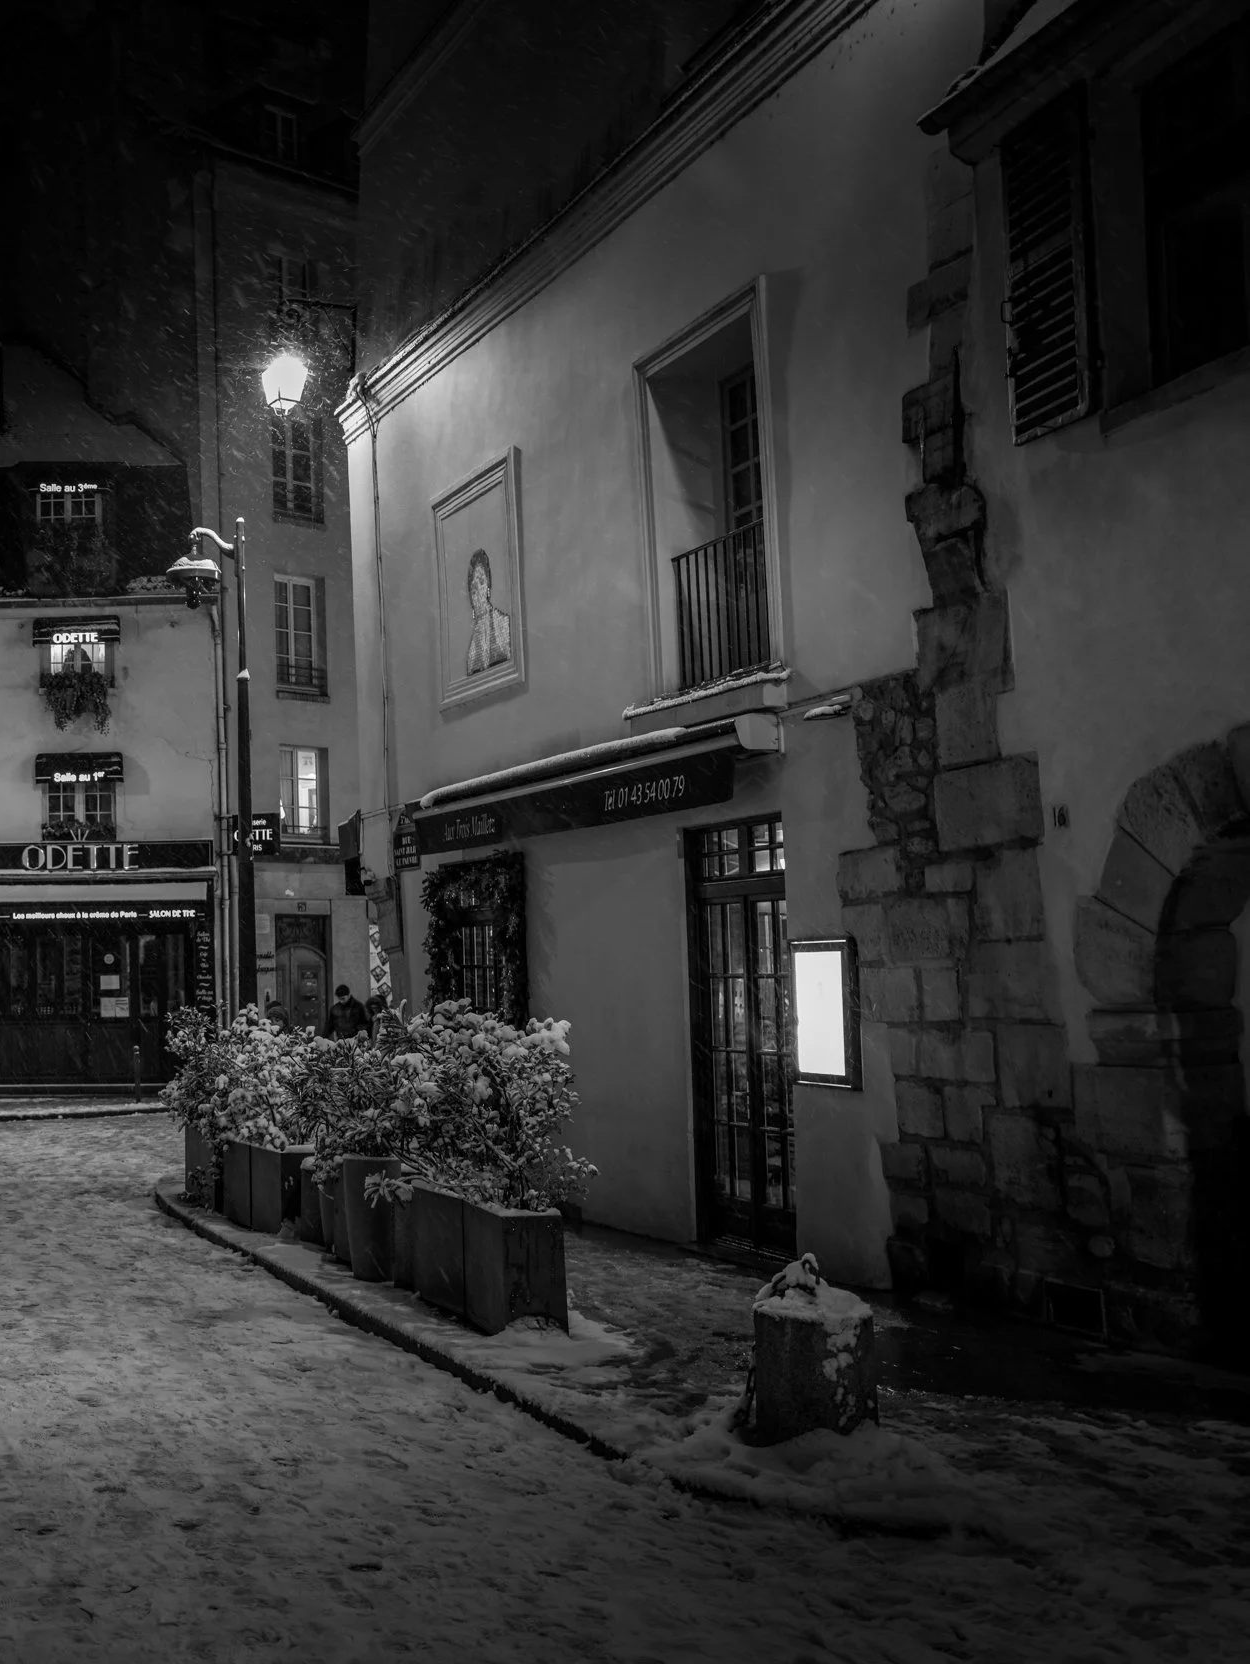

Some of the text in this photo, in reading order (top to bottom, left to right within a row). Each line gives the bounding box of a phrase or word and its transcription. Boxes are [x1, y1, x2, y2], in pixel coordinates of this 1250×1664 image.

[39, 483, 62, 492] Salle
[63, 484, 76, 492] au
[52, 632, 99, 644] ODETTE
[53, 772, 77, 782] Salle
[78, 774, 91, 782] au
[617, 787, 630, 809] 01
[630, 784, 643, 805] 43
[644, 782, 656, 803] 54
[657, 778, 670, 801] 00
[672, 775, 685, 798] 79
[22, 844, 139, 870] ODETTE
[120, 910, 137, 918] Paris
[149, 910, 171, 918] SALON
[172, 909, 181, 918] DE
